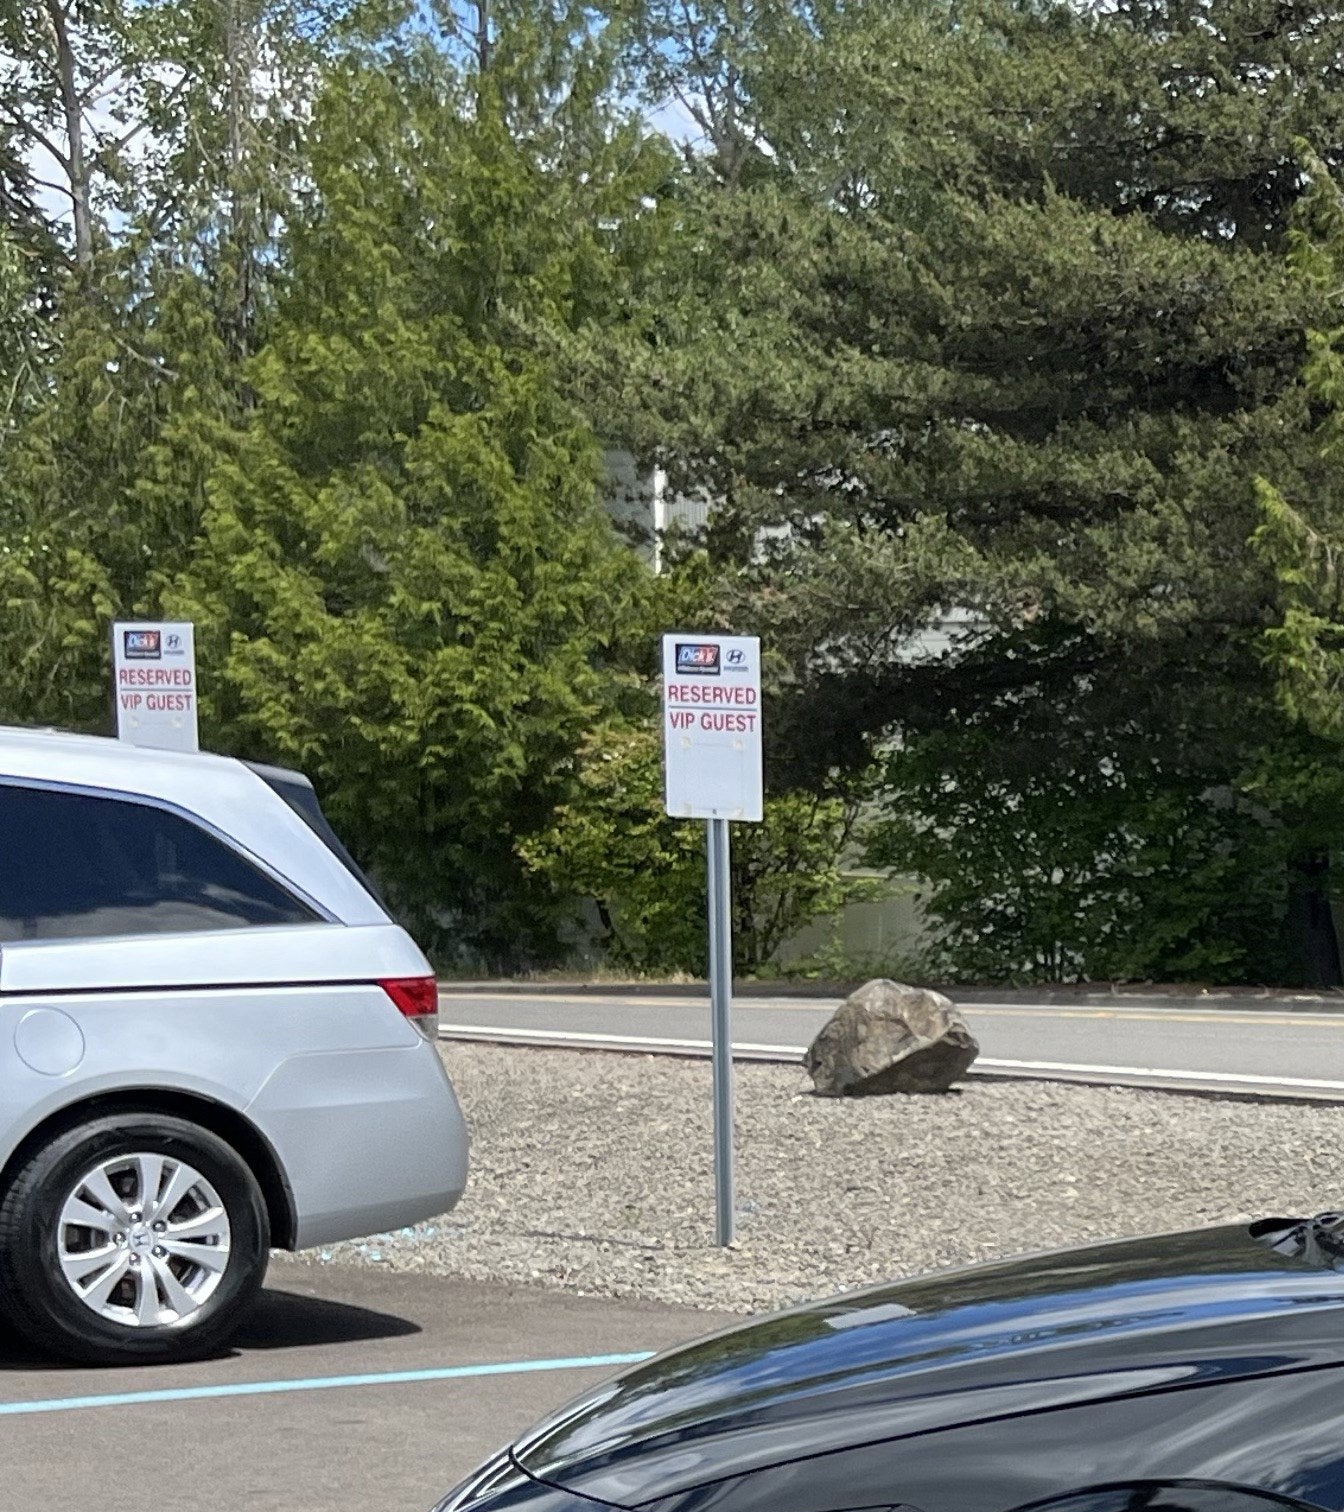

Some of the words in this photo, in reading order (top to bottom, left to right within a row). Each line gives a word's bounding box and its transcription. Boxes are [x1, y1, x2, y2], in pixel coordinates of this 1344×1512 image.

[119, 669, 192, 686] RESERVED
[120, 694, 142, 710] VIP
[146, 694, 193, 711] GUEST
[668, 685, 757, 705] RESERVED
[669, 712, 695, 730] VIP
[700, 713, 757, 732] GUEST
